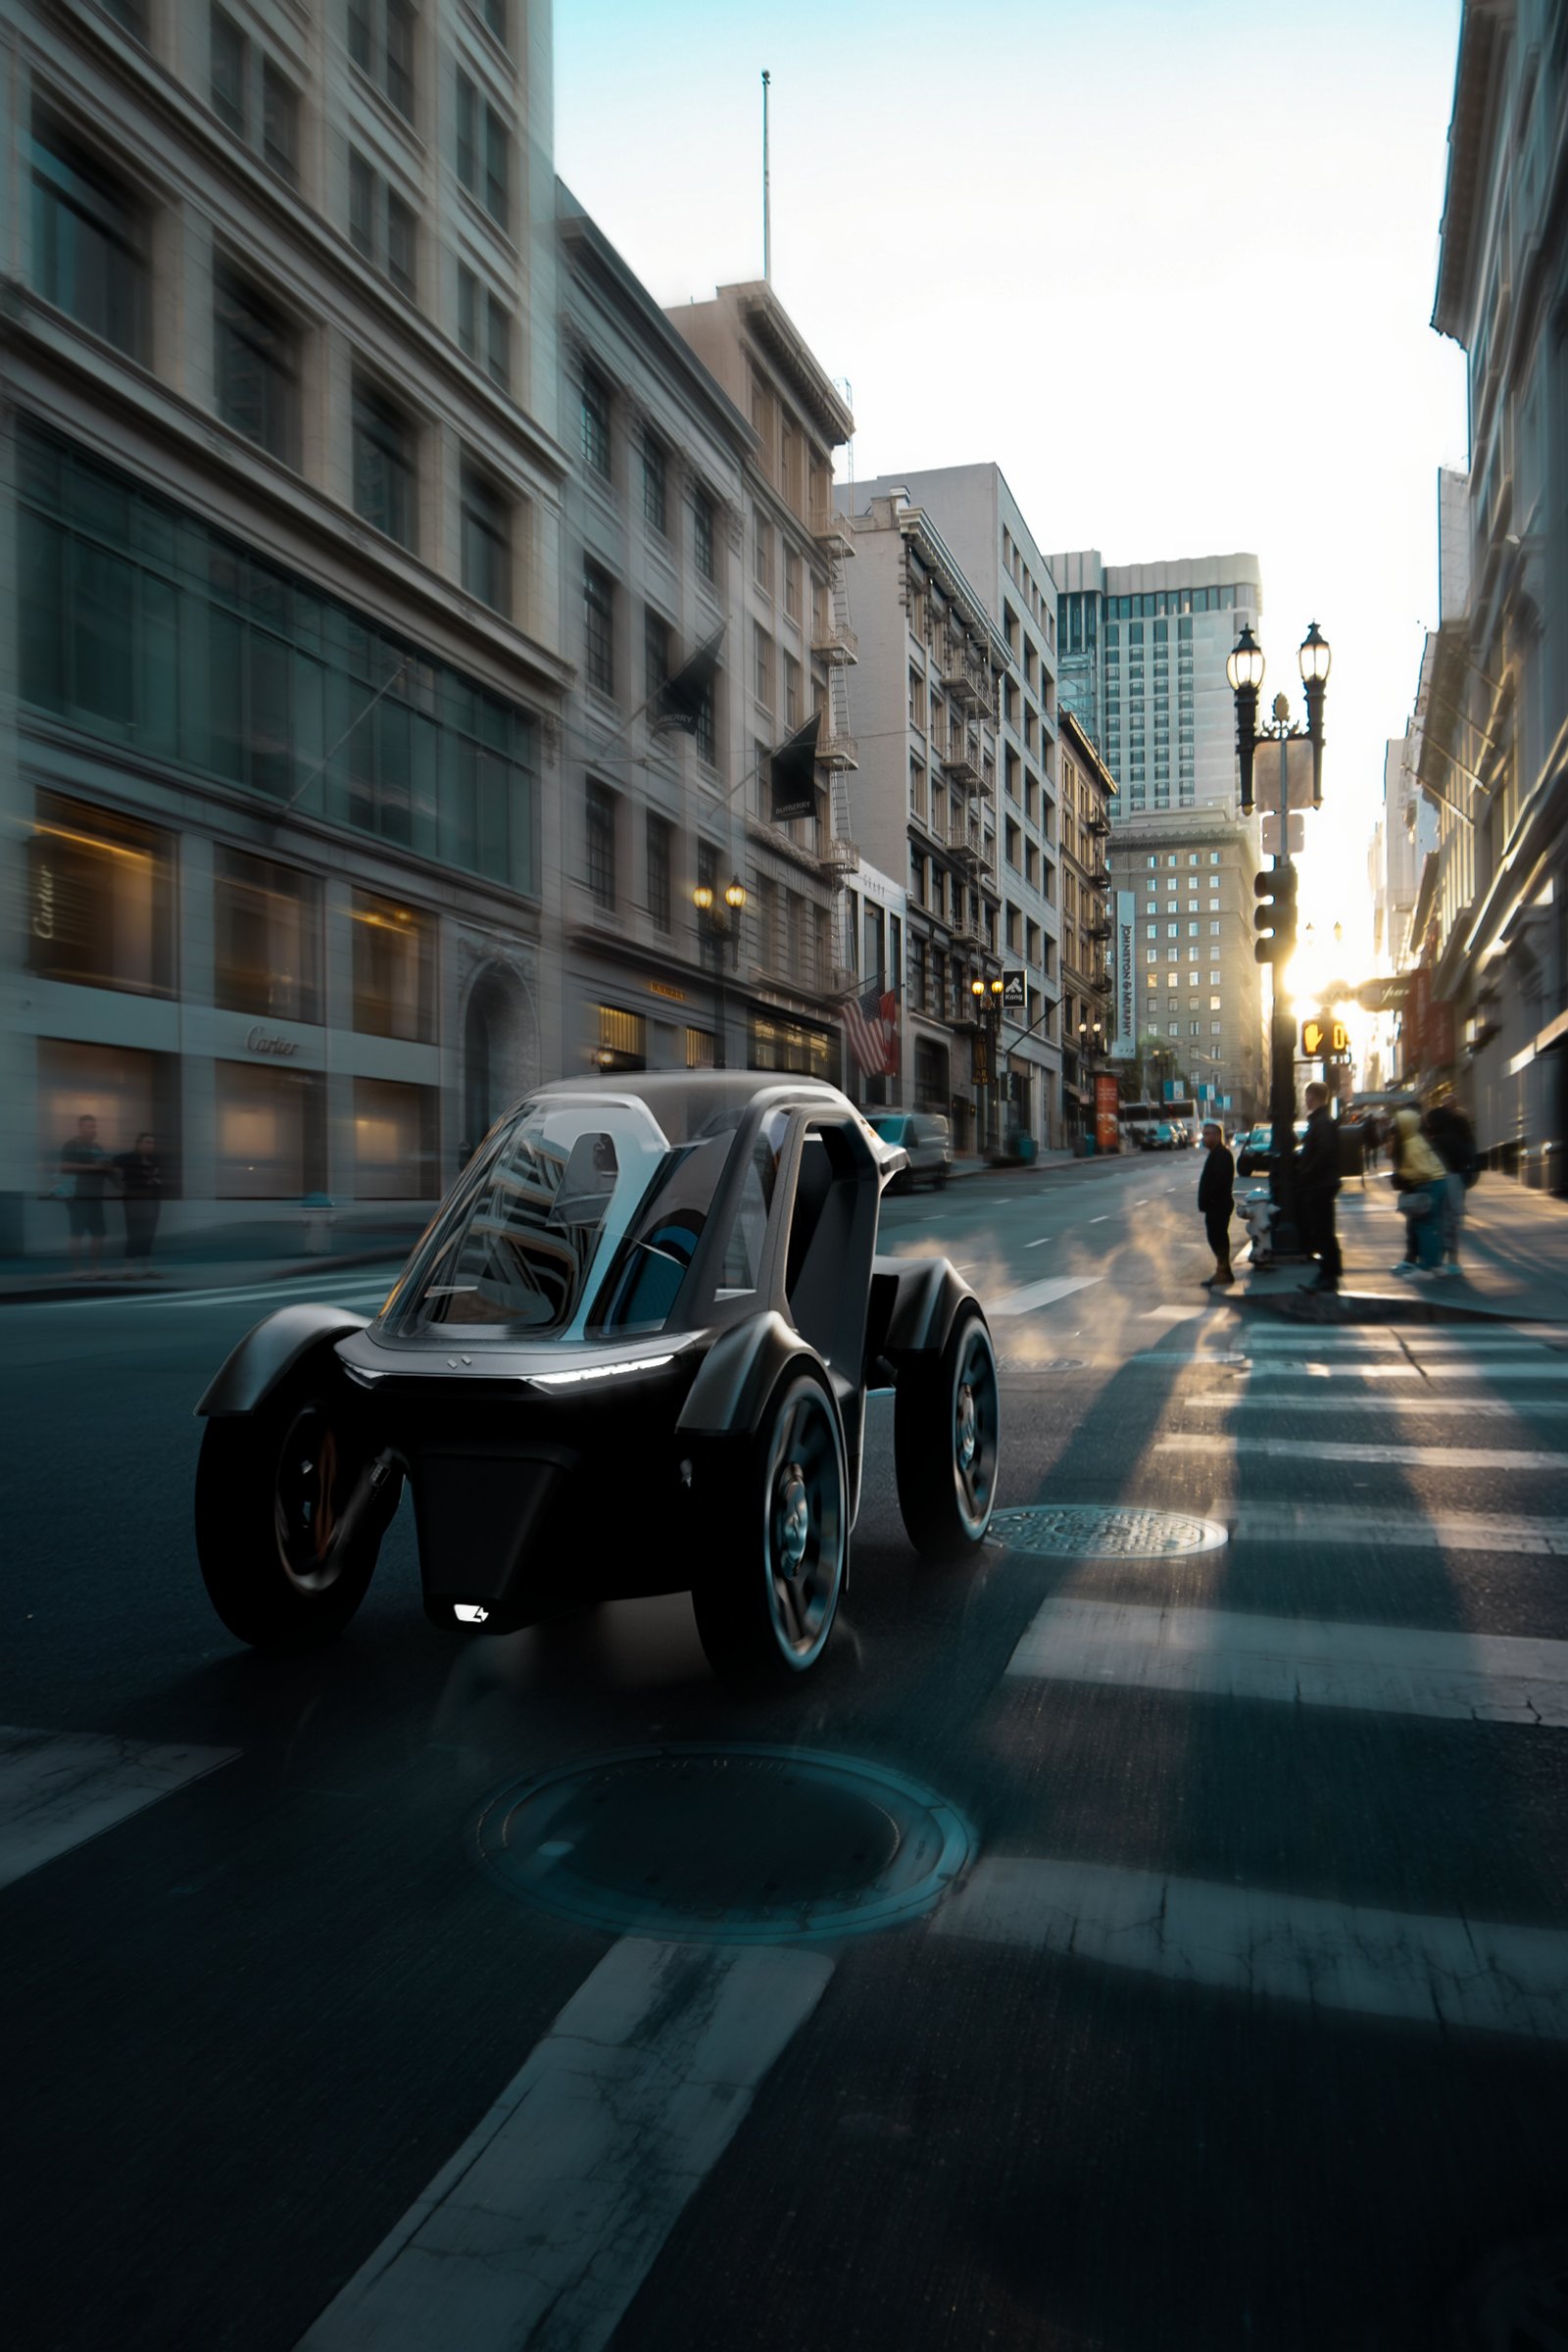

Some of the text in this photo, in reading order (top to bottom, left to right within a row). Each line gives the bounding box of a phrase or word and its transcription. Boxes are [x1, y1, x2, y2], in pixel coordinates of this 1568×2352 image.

[775, 801, 811, 814] BURBERRY
[32, 864, 54, 940] Cartier
[244, 1025, 300, 1057] Cartier
